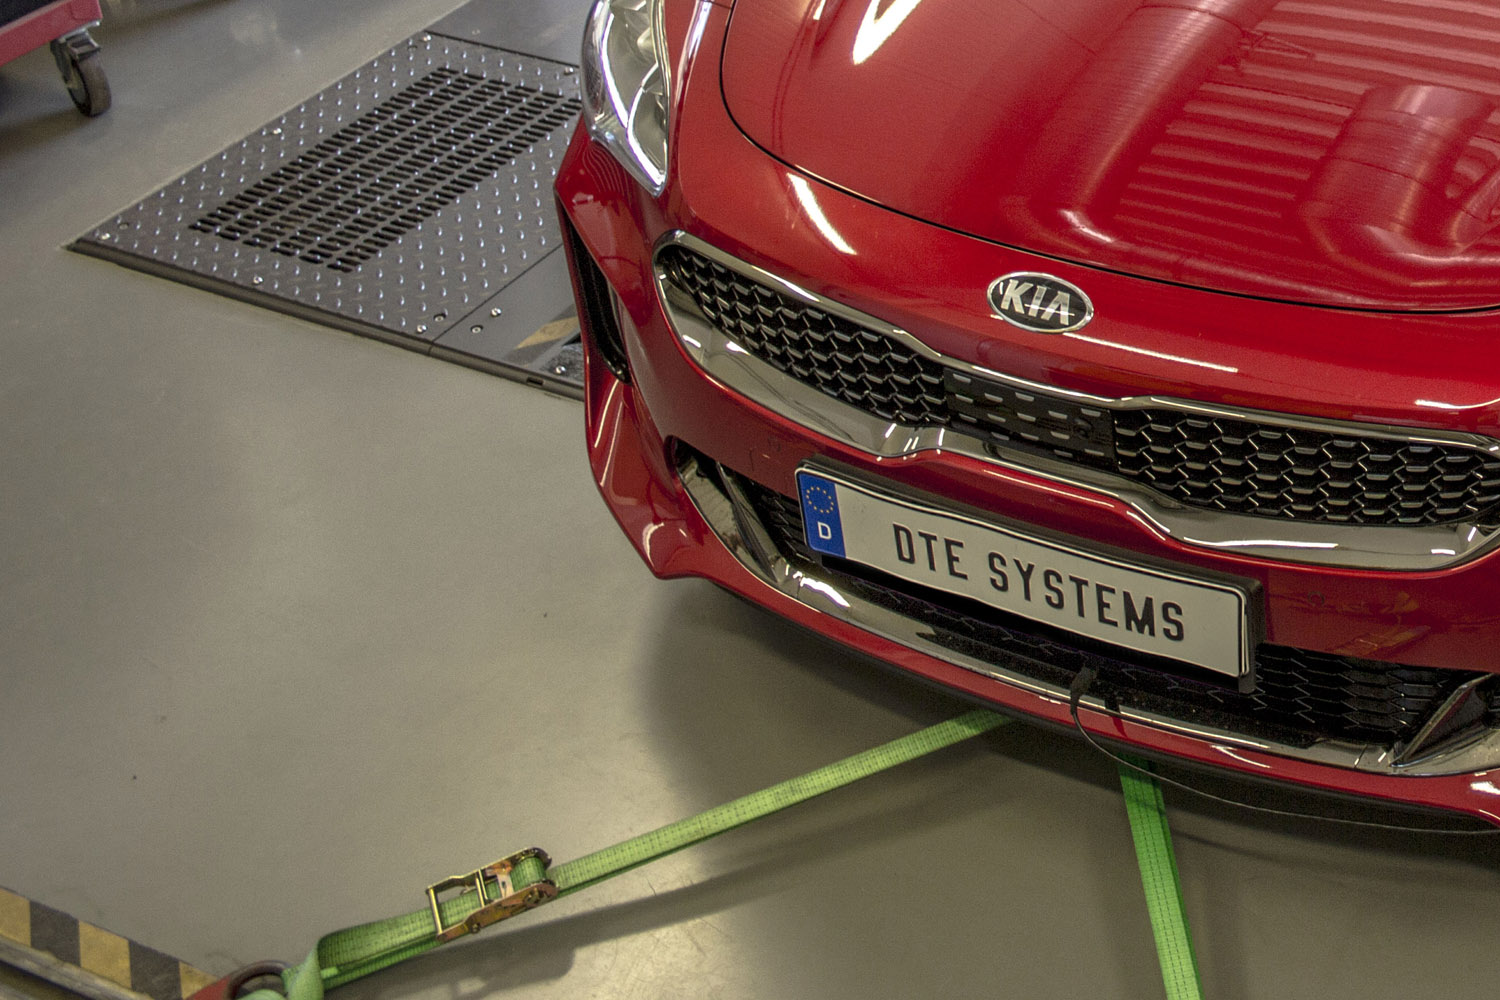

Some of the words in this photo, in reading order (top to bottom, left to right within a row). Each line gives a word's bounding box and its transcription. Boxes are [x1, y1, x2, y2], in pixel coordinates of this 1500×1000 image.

[1000, 278, 1071, 326] KIA
[817, 521, 832, 540] D
[892, 521, 969, 581] DTE
[987, 551, 1185, 642] SYSTEMS
